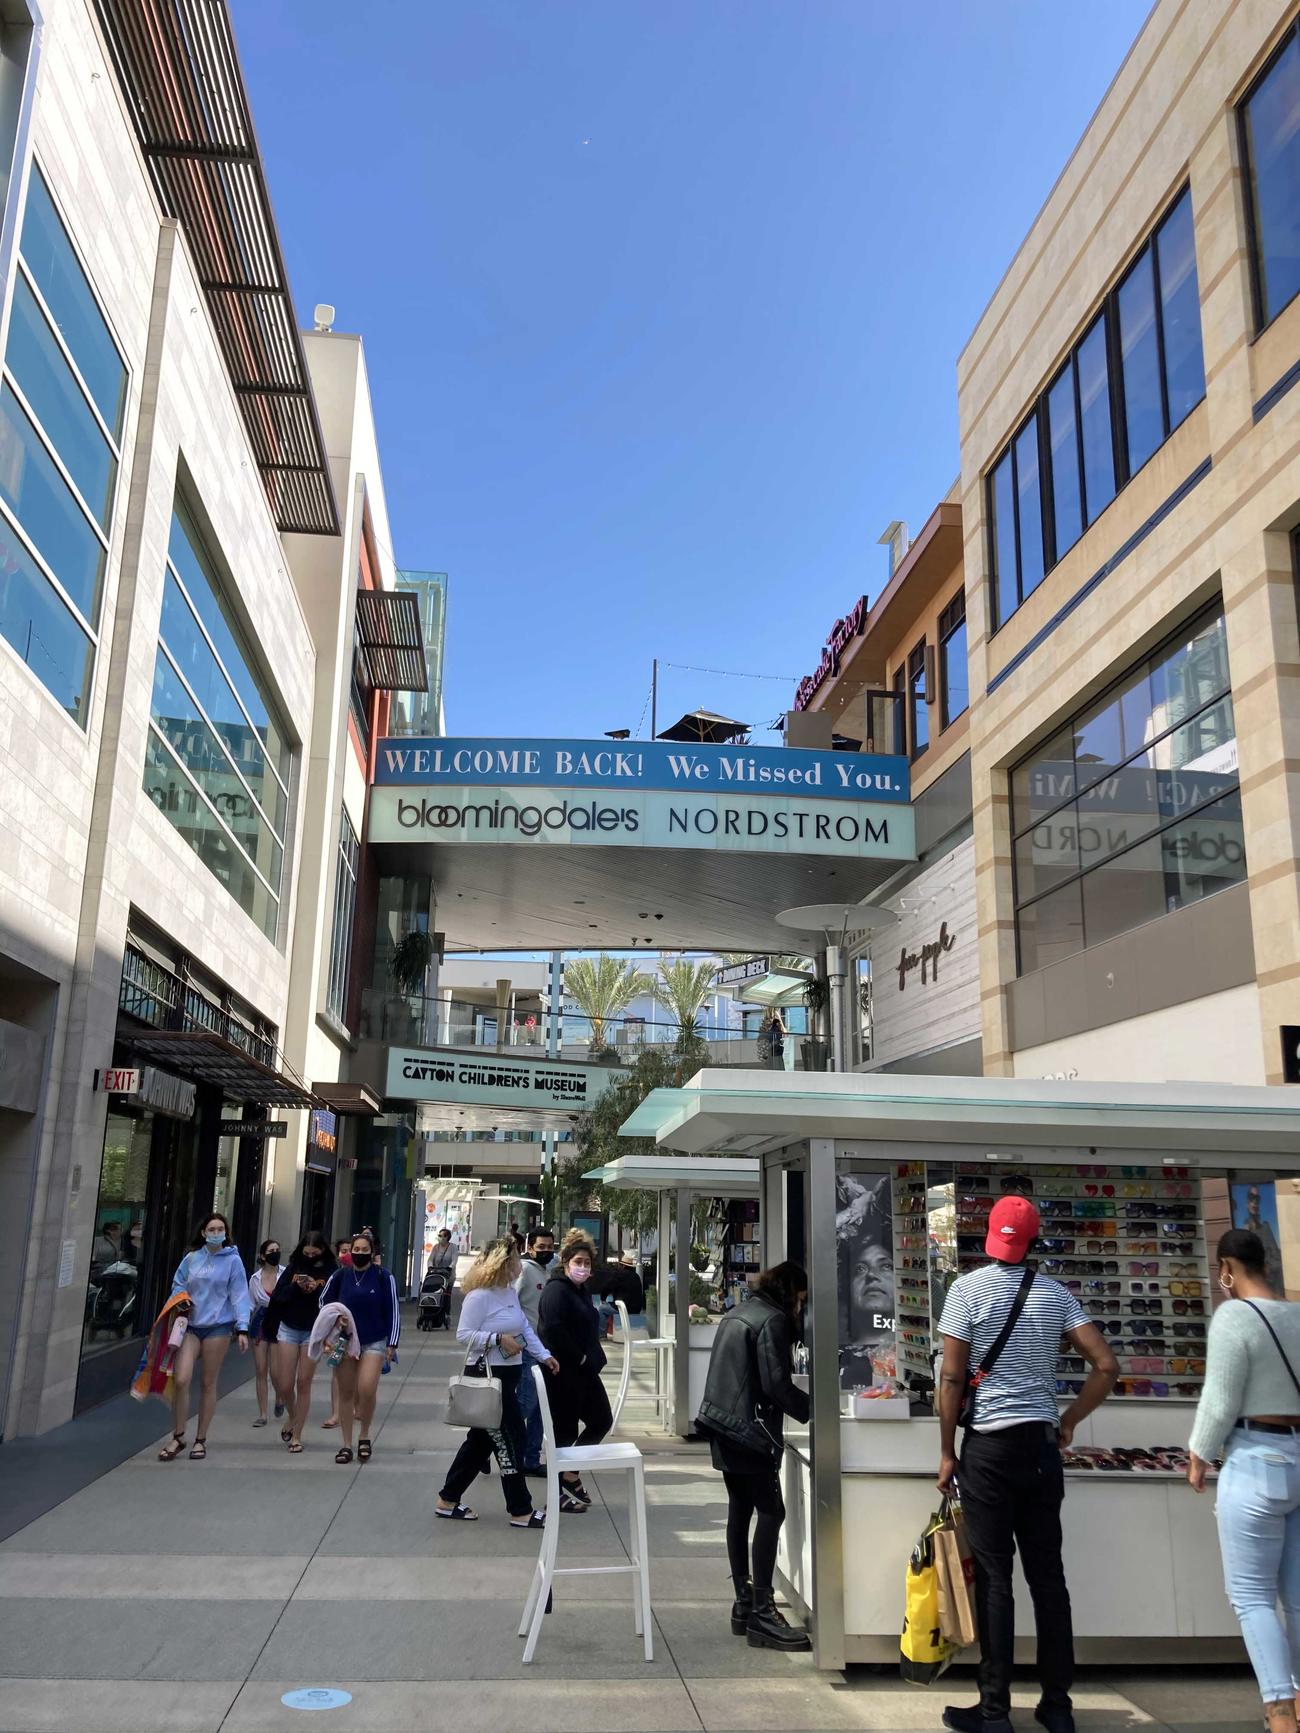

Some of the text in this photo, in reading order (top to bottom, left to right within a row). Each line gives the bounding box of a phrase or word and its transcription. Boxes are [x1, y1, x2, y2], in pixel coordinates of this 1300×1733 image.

[385, 750, 901, 791] WELCOME BACK! We Missed You.
[397, 799, 889, 844] bloomingdale's NORDSTROM
[104, 1071, 133, 1092] EXIT
[403, 1066, 586, 1092] CAYTON CHILDREN'S MUSEUM
[223, 1123, 283, 1133] JOHNNY WAS
